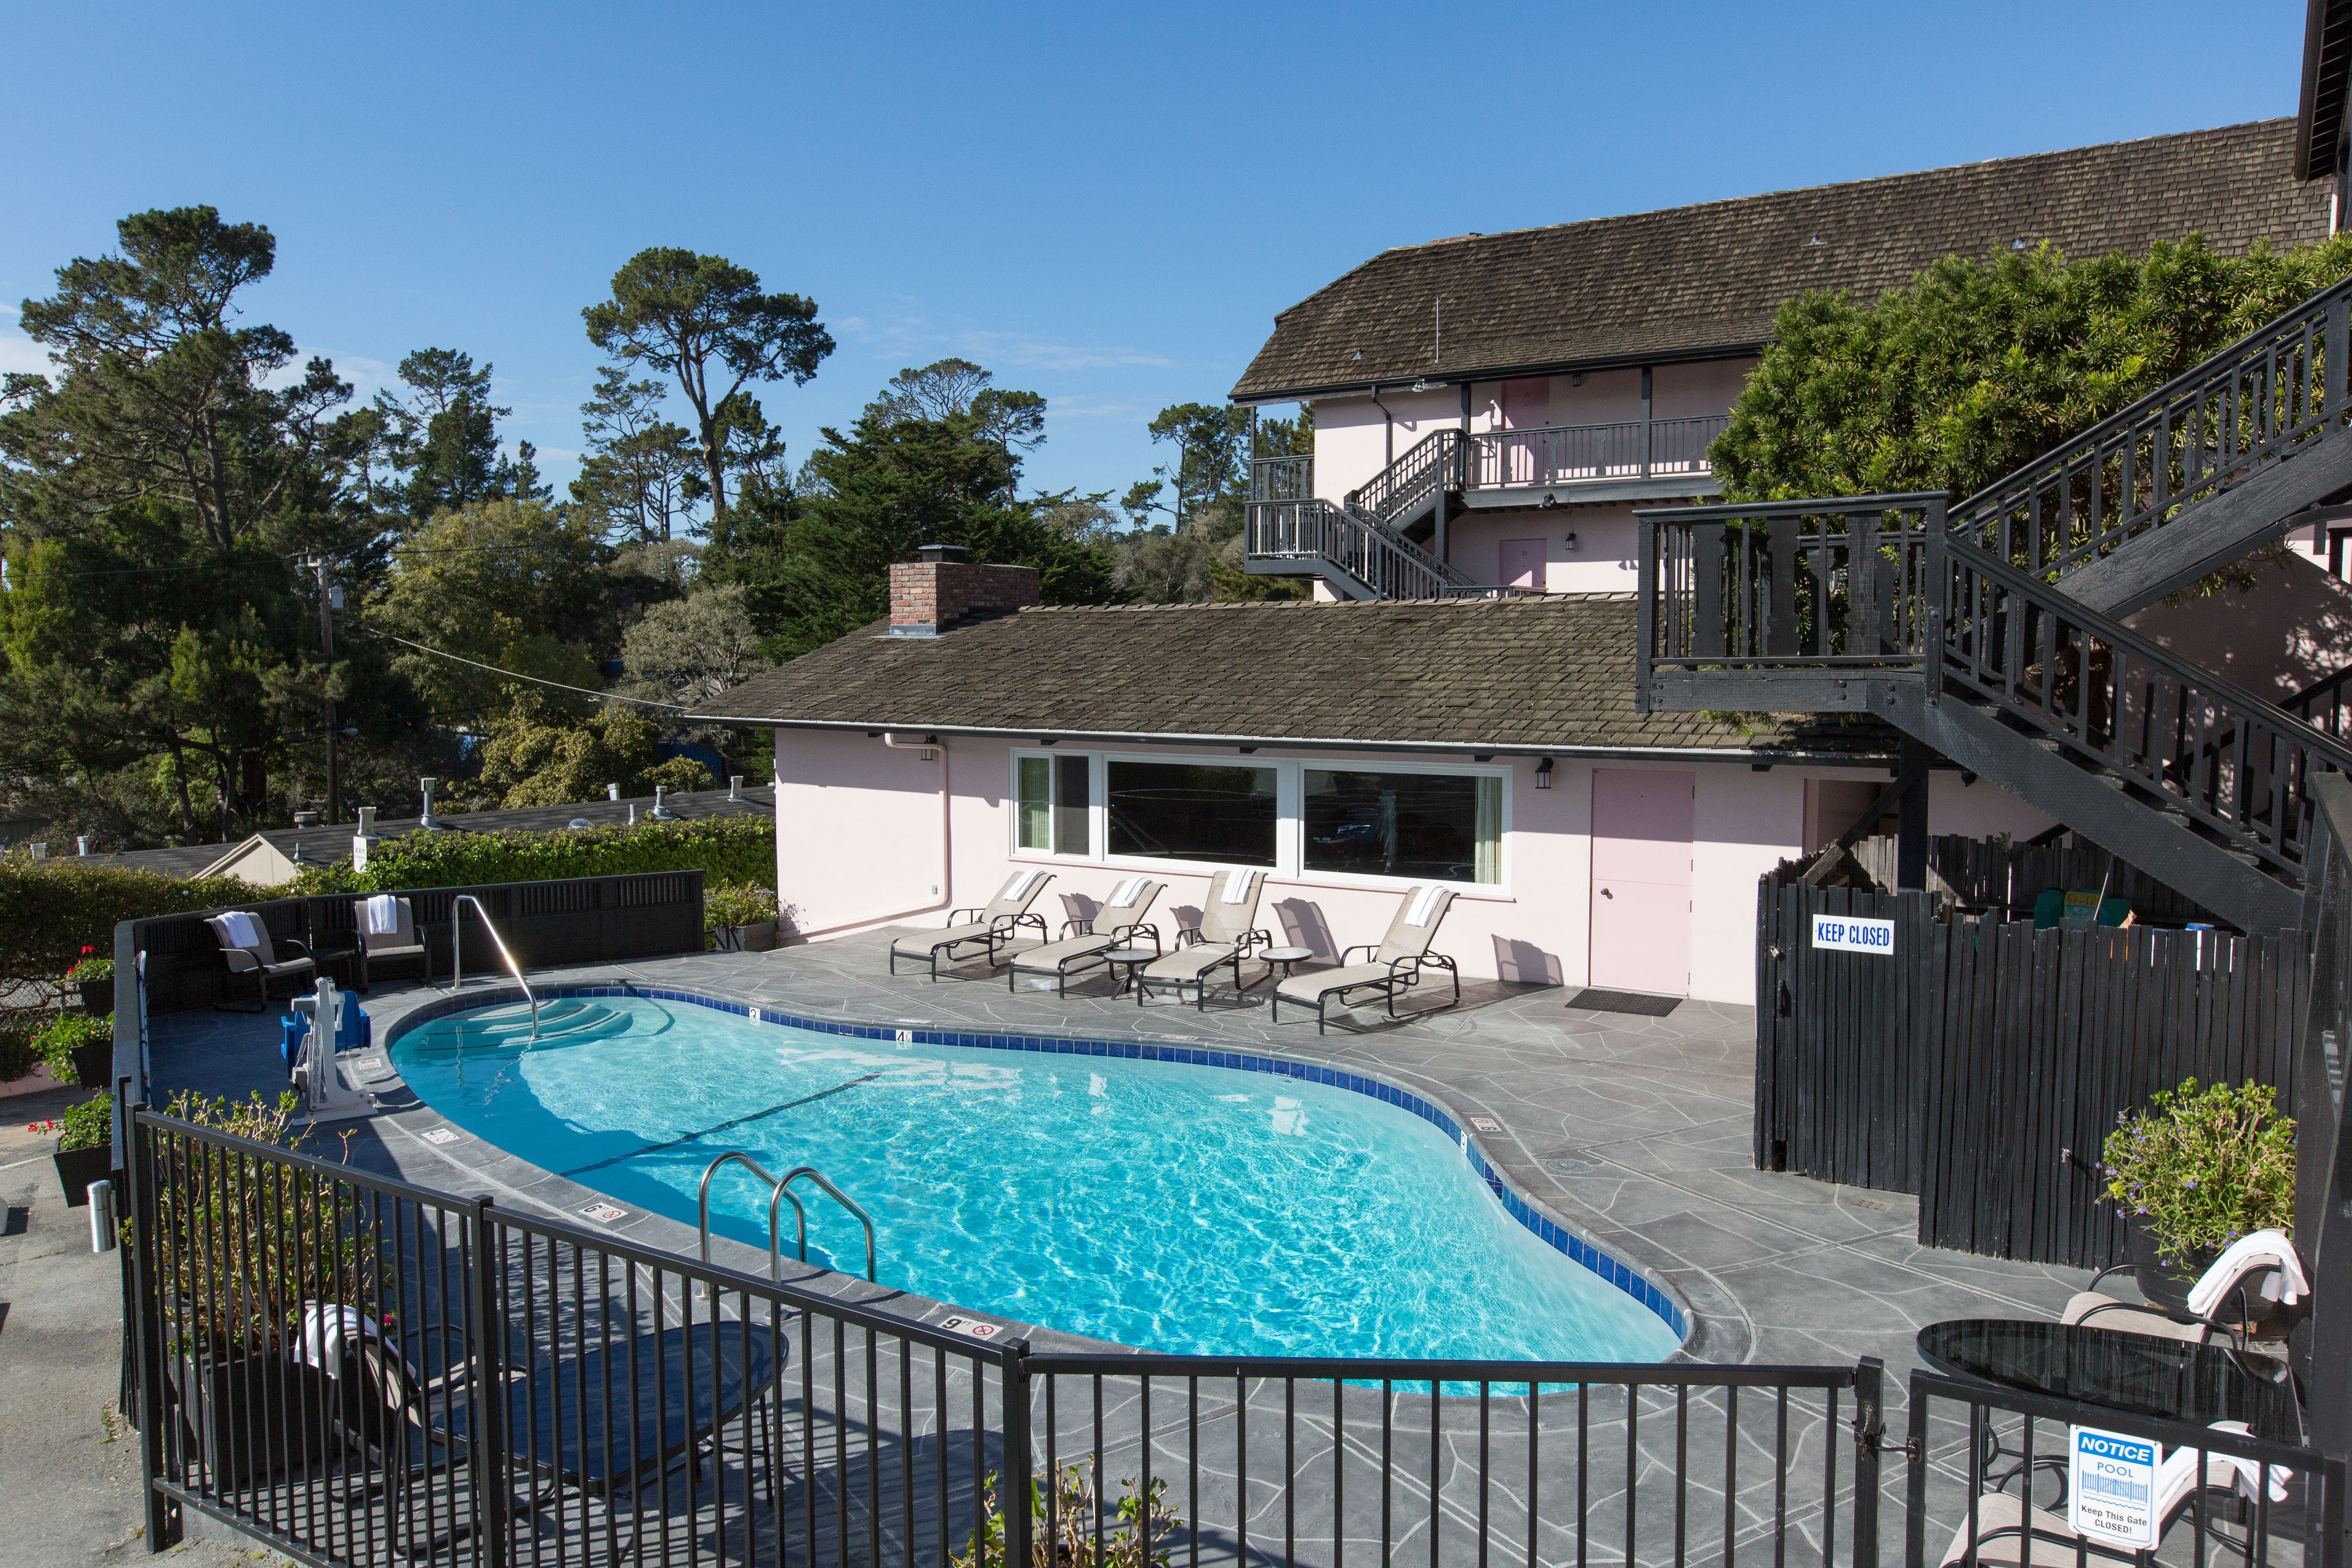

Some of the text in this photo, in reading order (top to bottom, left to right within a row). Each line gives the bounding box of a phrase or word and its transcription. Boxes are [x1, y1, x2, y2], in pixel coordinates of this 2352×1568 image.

[1818, 922, 1890, 946] KEEP CLOSED
[942, 1318, 962, 1329] 9
[2081, 1436, 2151, 1462] NOTICE
[2097, 1462, 2134, 1478] POOL
[2081, 1504, 2147, 1526] Keep This Gate
[2095, 1519, 2132, 1534] CLOSED!
